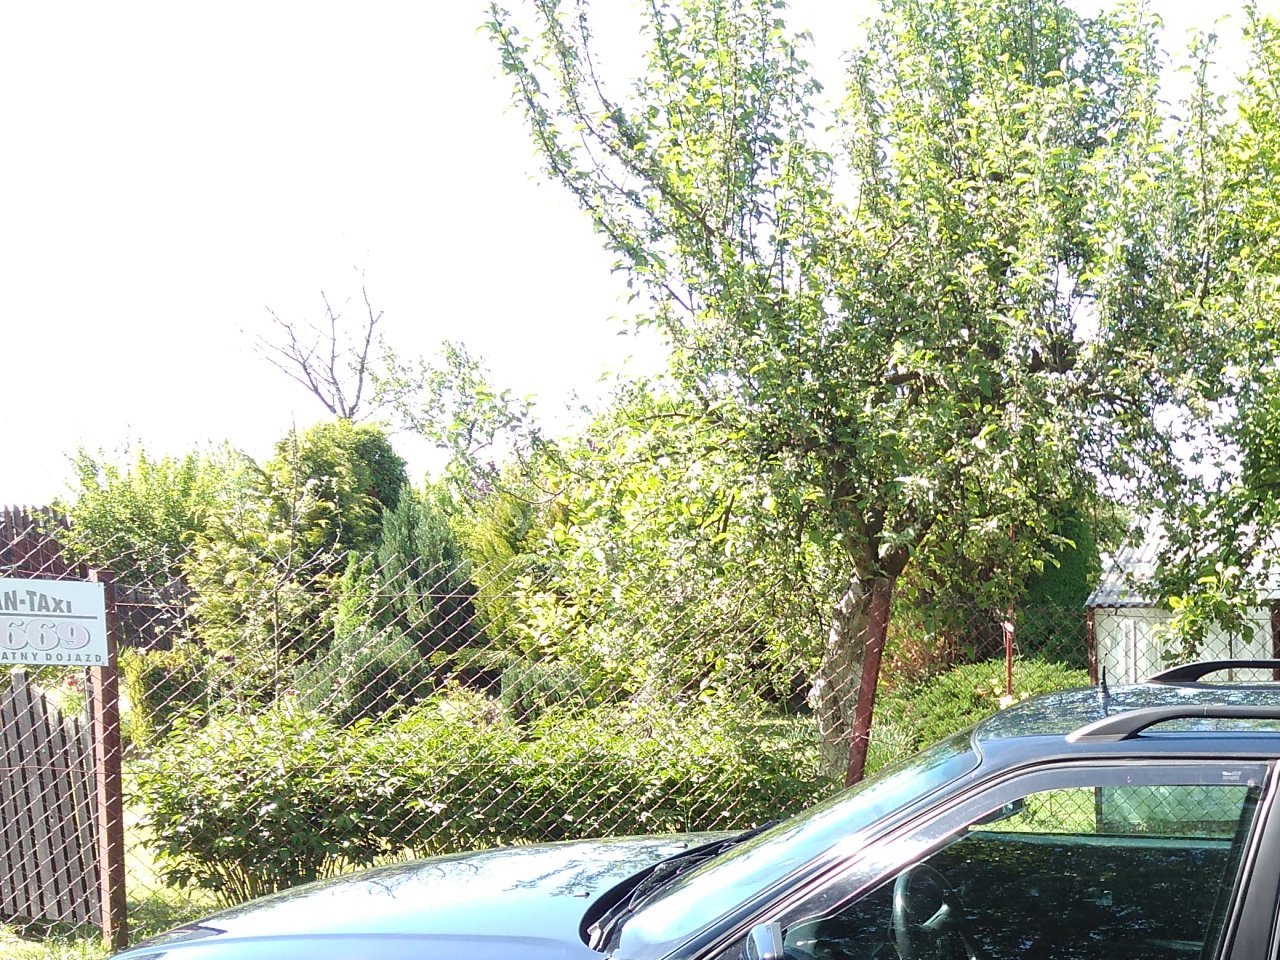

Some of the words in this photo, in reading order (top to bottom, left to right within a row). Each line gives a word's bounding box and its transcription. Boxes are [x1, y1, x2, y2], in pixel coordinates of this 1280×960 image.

[0, 590, 72, 613] N-TAXI
[0, 619, 90, 651] 669
[45, 653, 102, 662] DOJAZD
